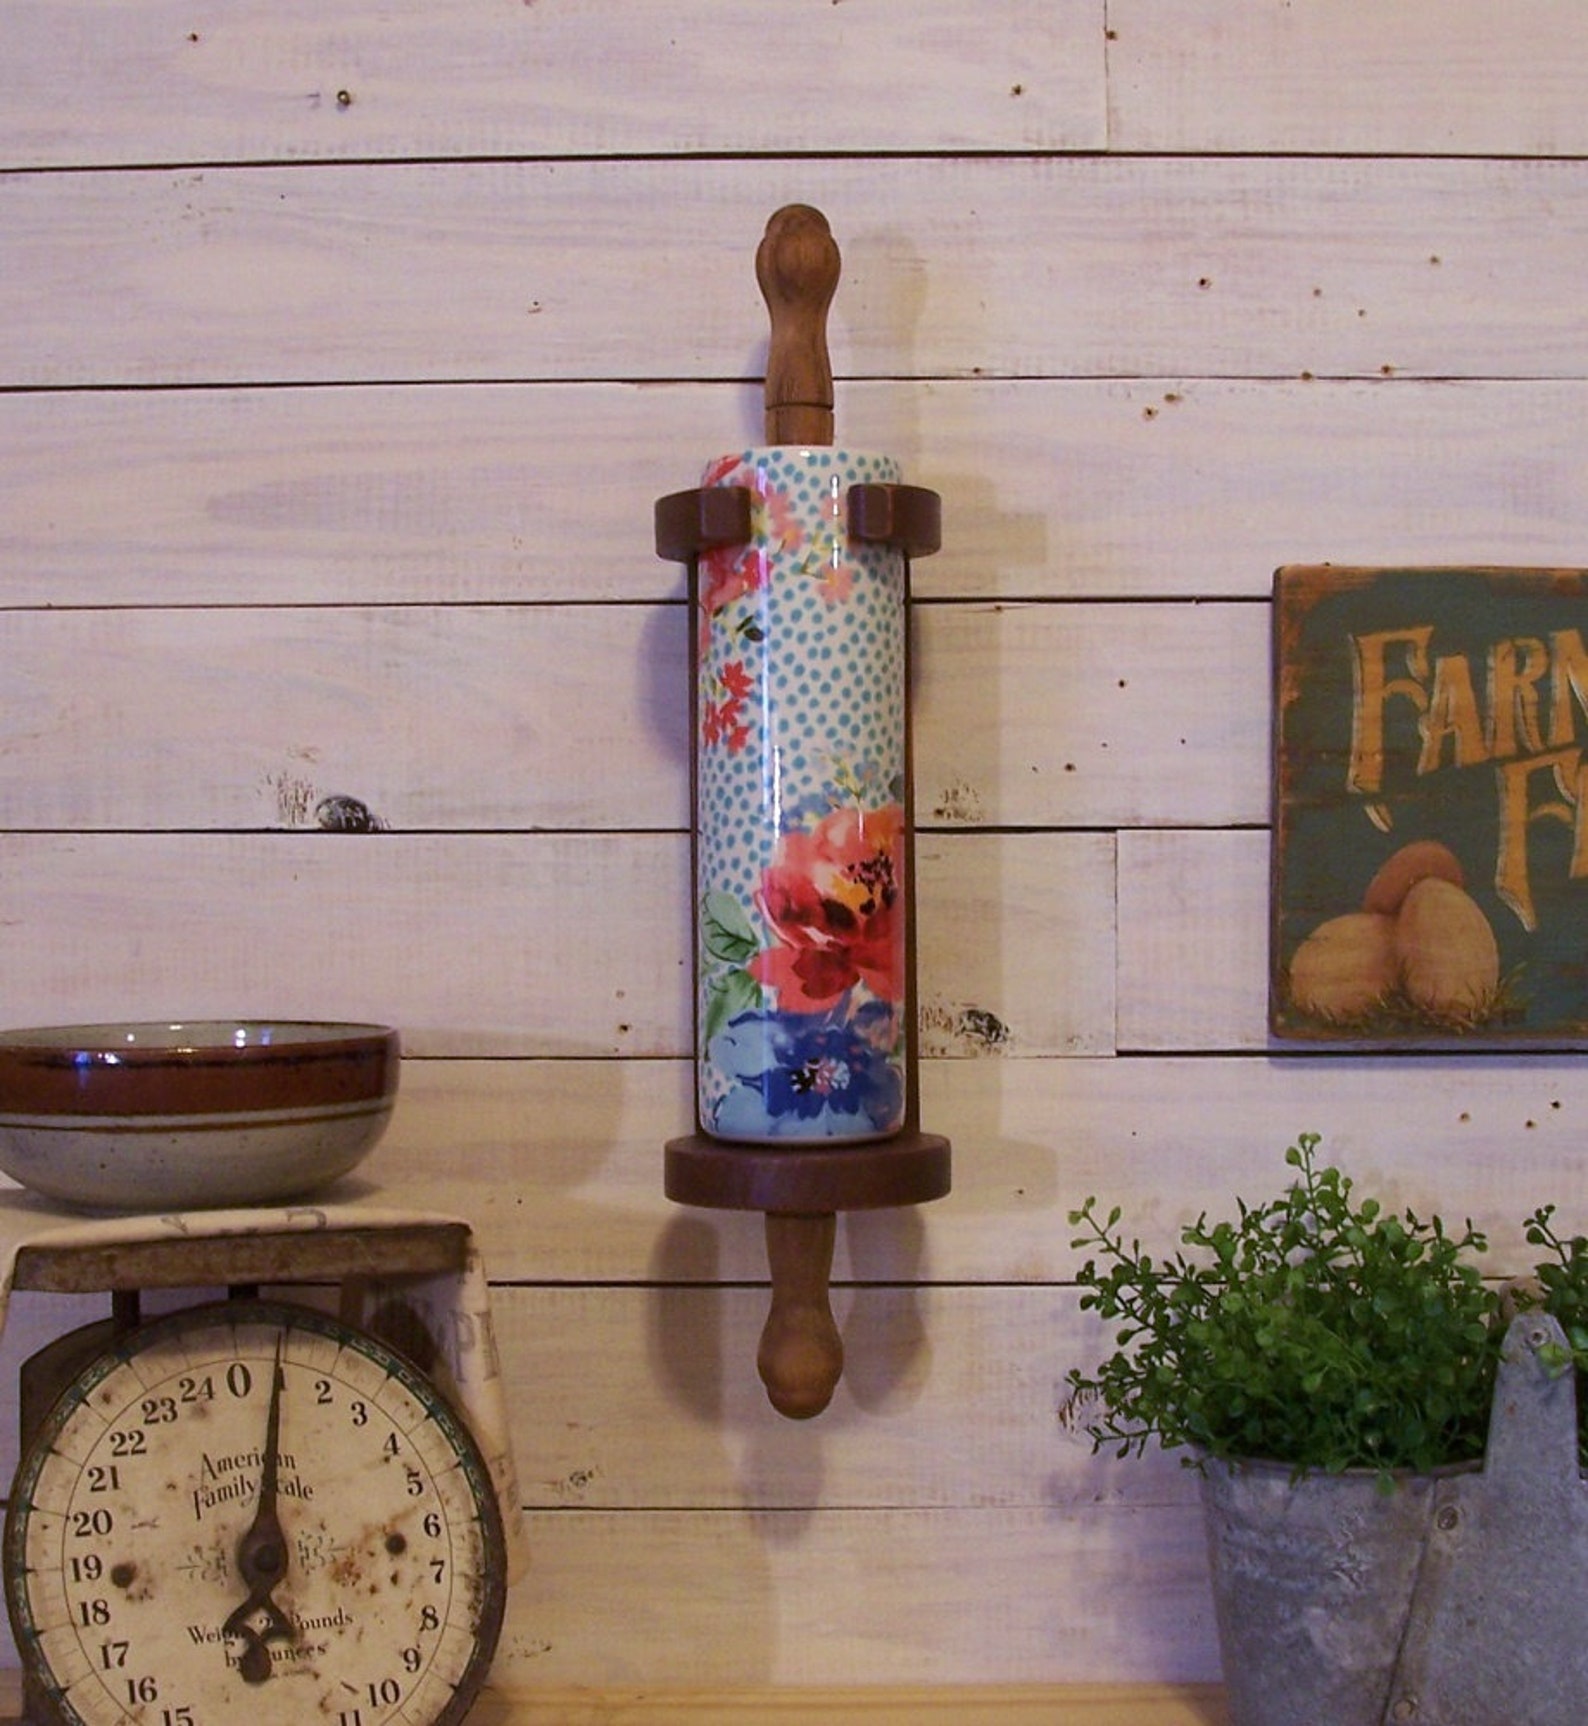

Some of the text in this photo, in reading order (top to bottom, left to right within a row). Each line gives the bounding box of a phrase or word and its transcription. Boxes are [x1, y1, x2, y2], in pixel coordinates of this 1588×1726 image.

[178, 1375, 216, 1403] 24
[226, 1362, 252, 1399] 0
[314, 1379, 334, 1405] 2
[141, 1397, 179, 1426] 23
[350, 1401, 369, 1427] 3
[109, 1429, 148, 1458] 22
[382, 1431, 401, 1456] 4
[87, 1464, 121, 1493] 21
[200, 1446, 297, 1492] Amerin
[406, 1469, 424, 1497] 5
[193, 1474, 314, 1521] Family ale
[72, 1508, 114, 1538] 20
[423, 1512, 442, 1539] 6
[70, 1554, 103, 1581] 19
[429, 1559, 445, 1585] 7
[79, 1599, 112, 1627] 18
[420, 1604, 440, 1631] 8
[99, 1640, 130, 1670] 17
[402, 1647, 422, 1674] 9
[126, 1675, 158, 1706] 16
[367, 1678, 401, 1708] 10
[161, 1706, 195, 1726] 15
